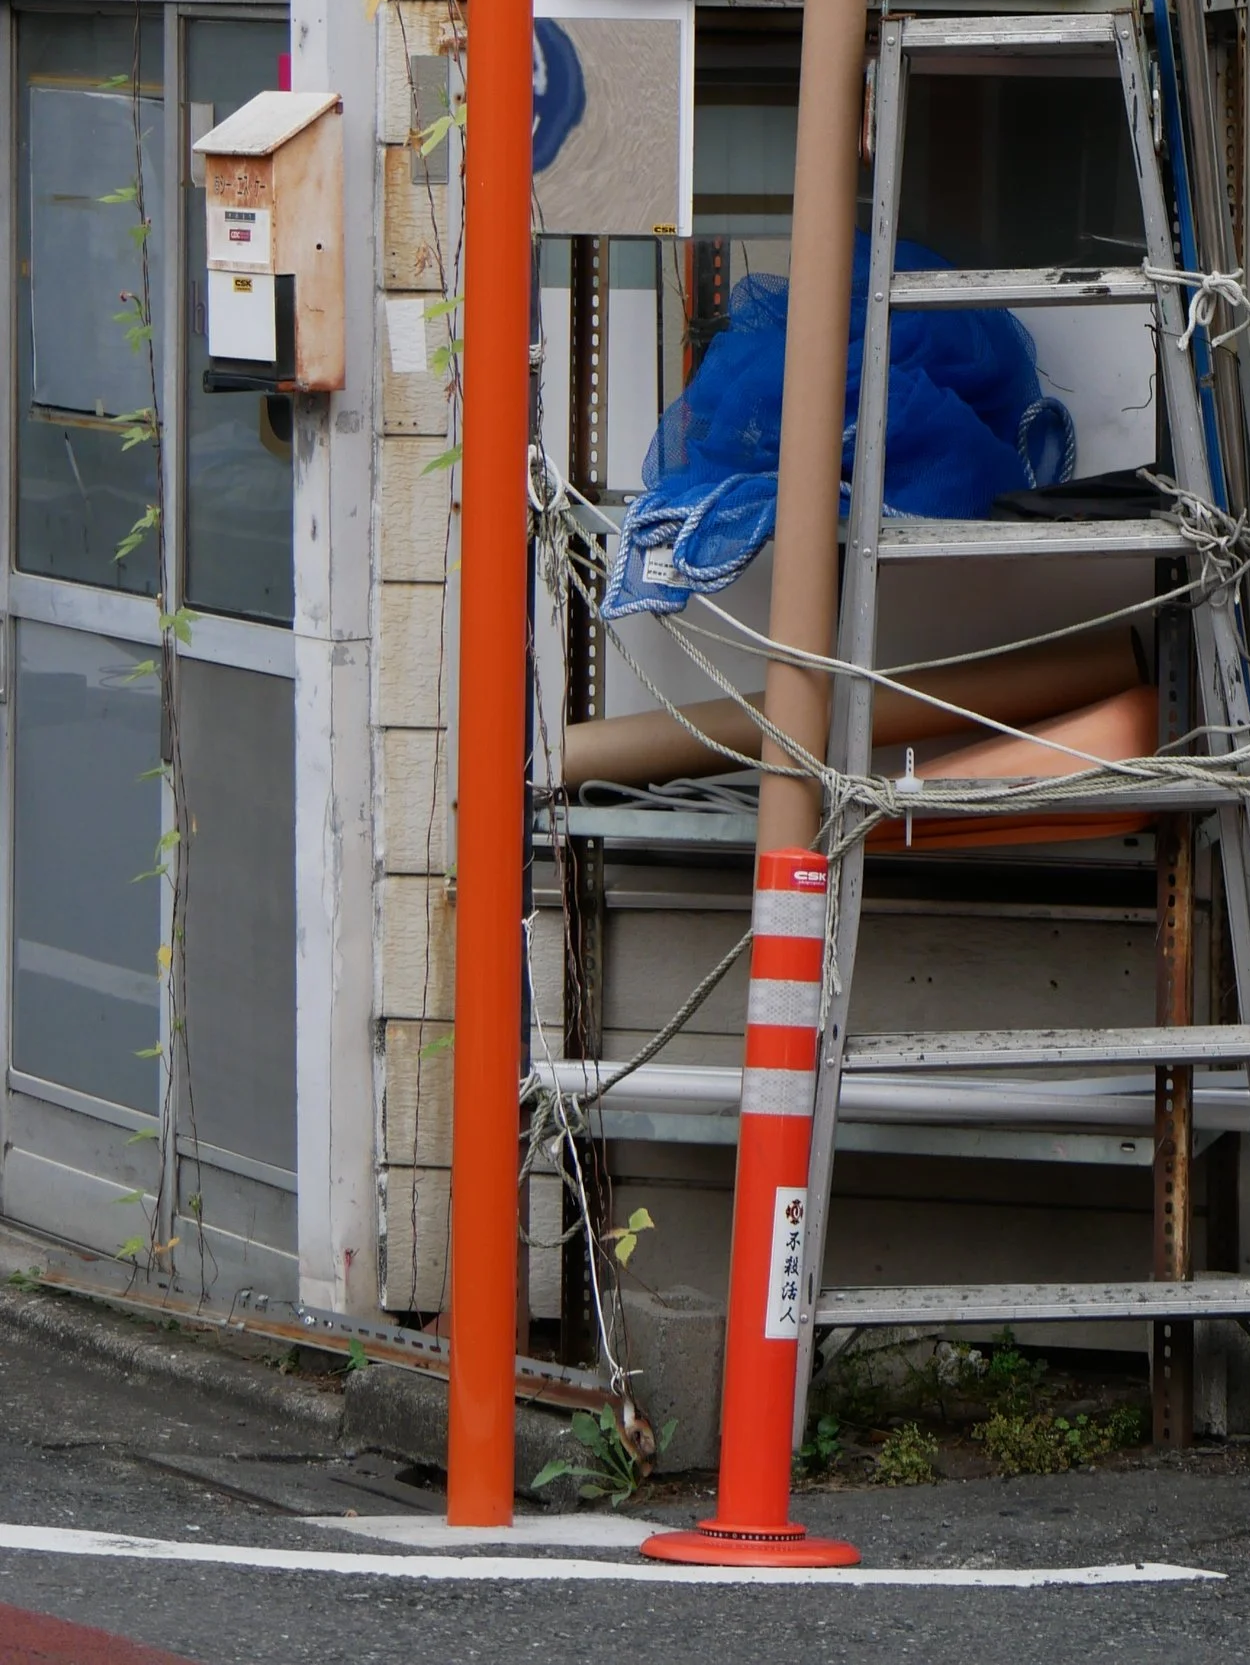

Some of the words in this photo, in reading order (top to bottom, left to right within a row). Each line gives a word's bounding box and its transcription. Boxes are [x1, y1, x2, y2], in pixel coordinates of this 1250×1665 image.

[794, 870, 827, 882] CSK
[779, 1232, 801, 1324] 不殺活人
